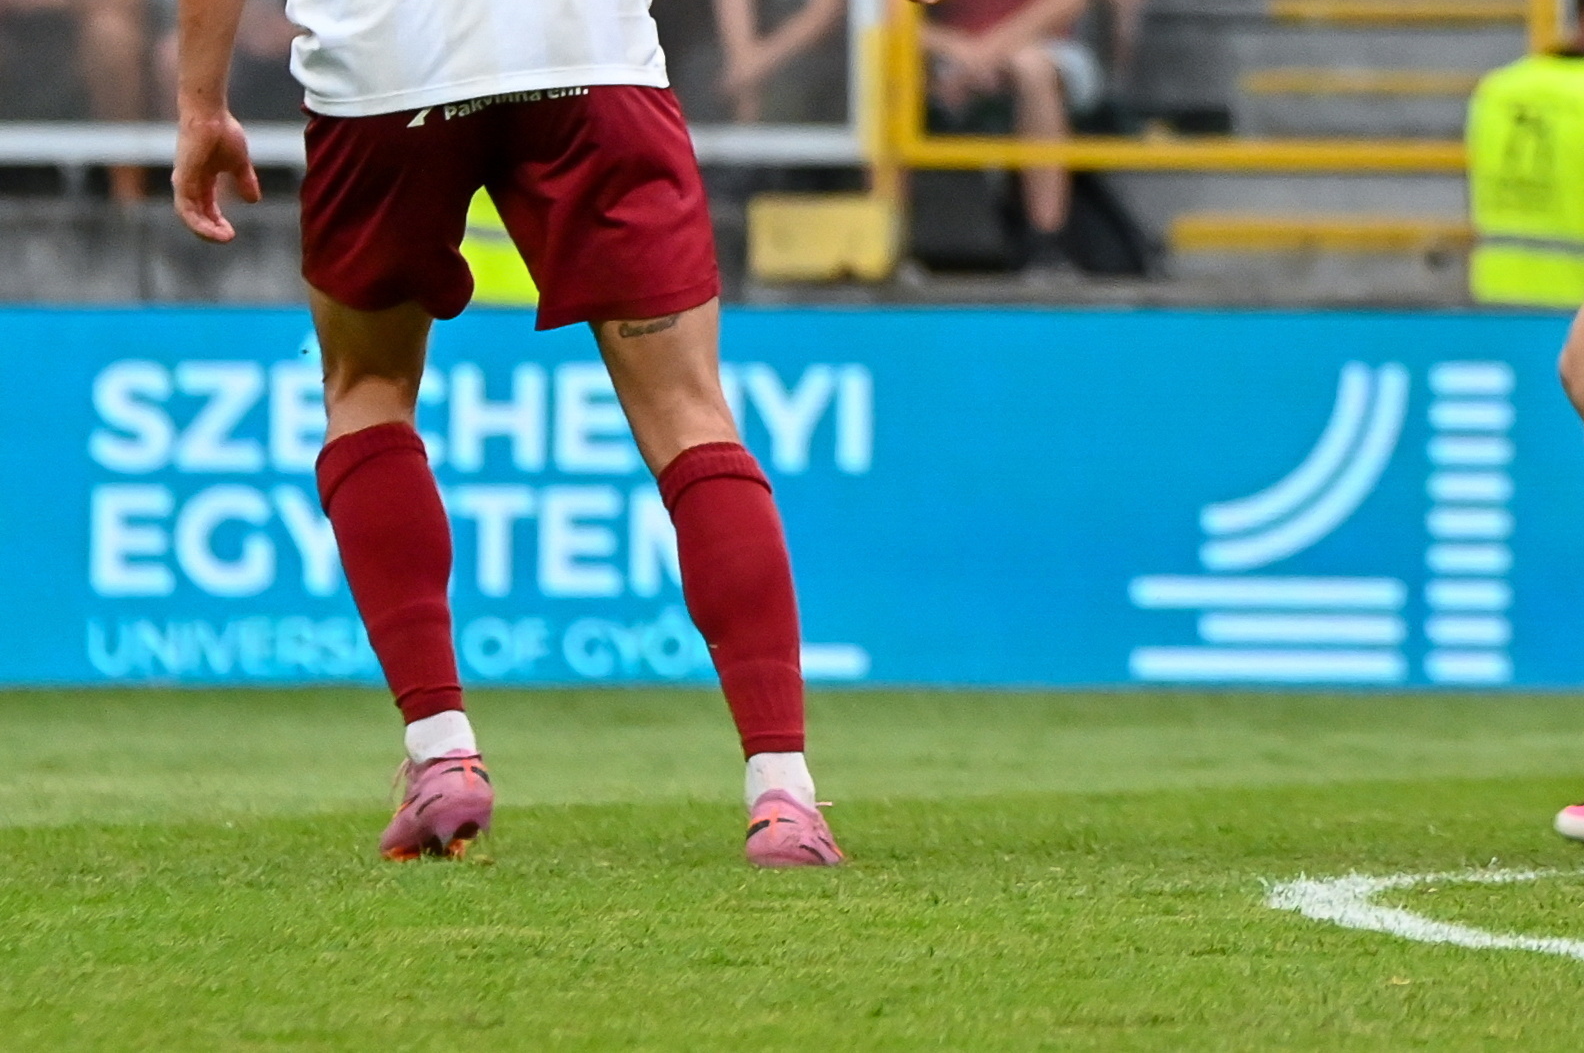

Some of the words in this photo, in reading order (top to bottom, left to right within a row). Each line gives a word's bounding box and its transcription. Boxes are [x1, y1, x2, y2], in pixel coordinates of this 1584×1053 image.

[88, 332, 876, 476] SZÉHEYI
[89, 482, 684, 599] EGYTE
[85, 616, 375, 678] UNIVERS
[461, 616, 550, 678] OF
